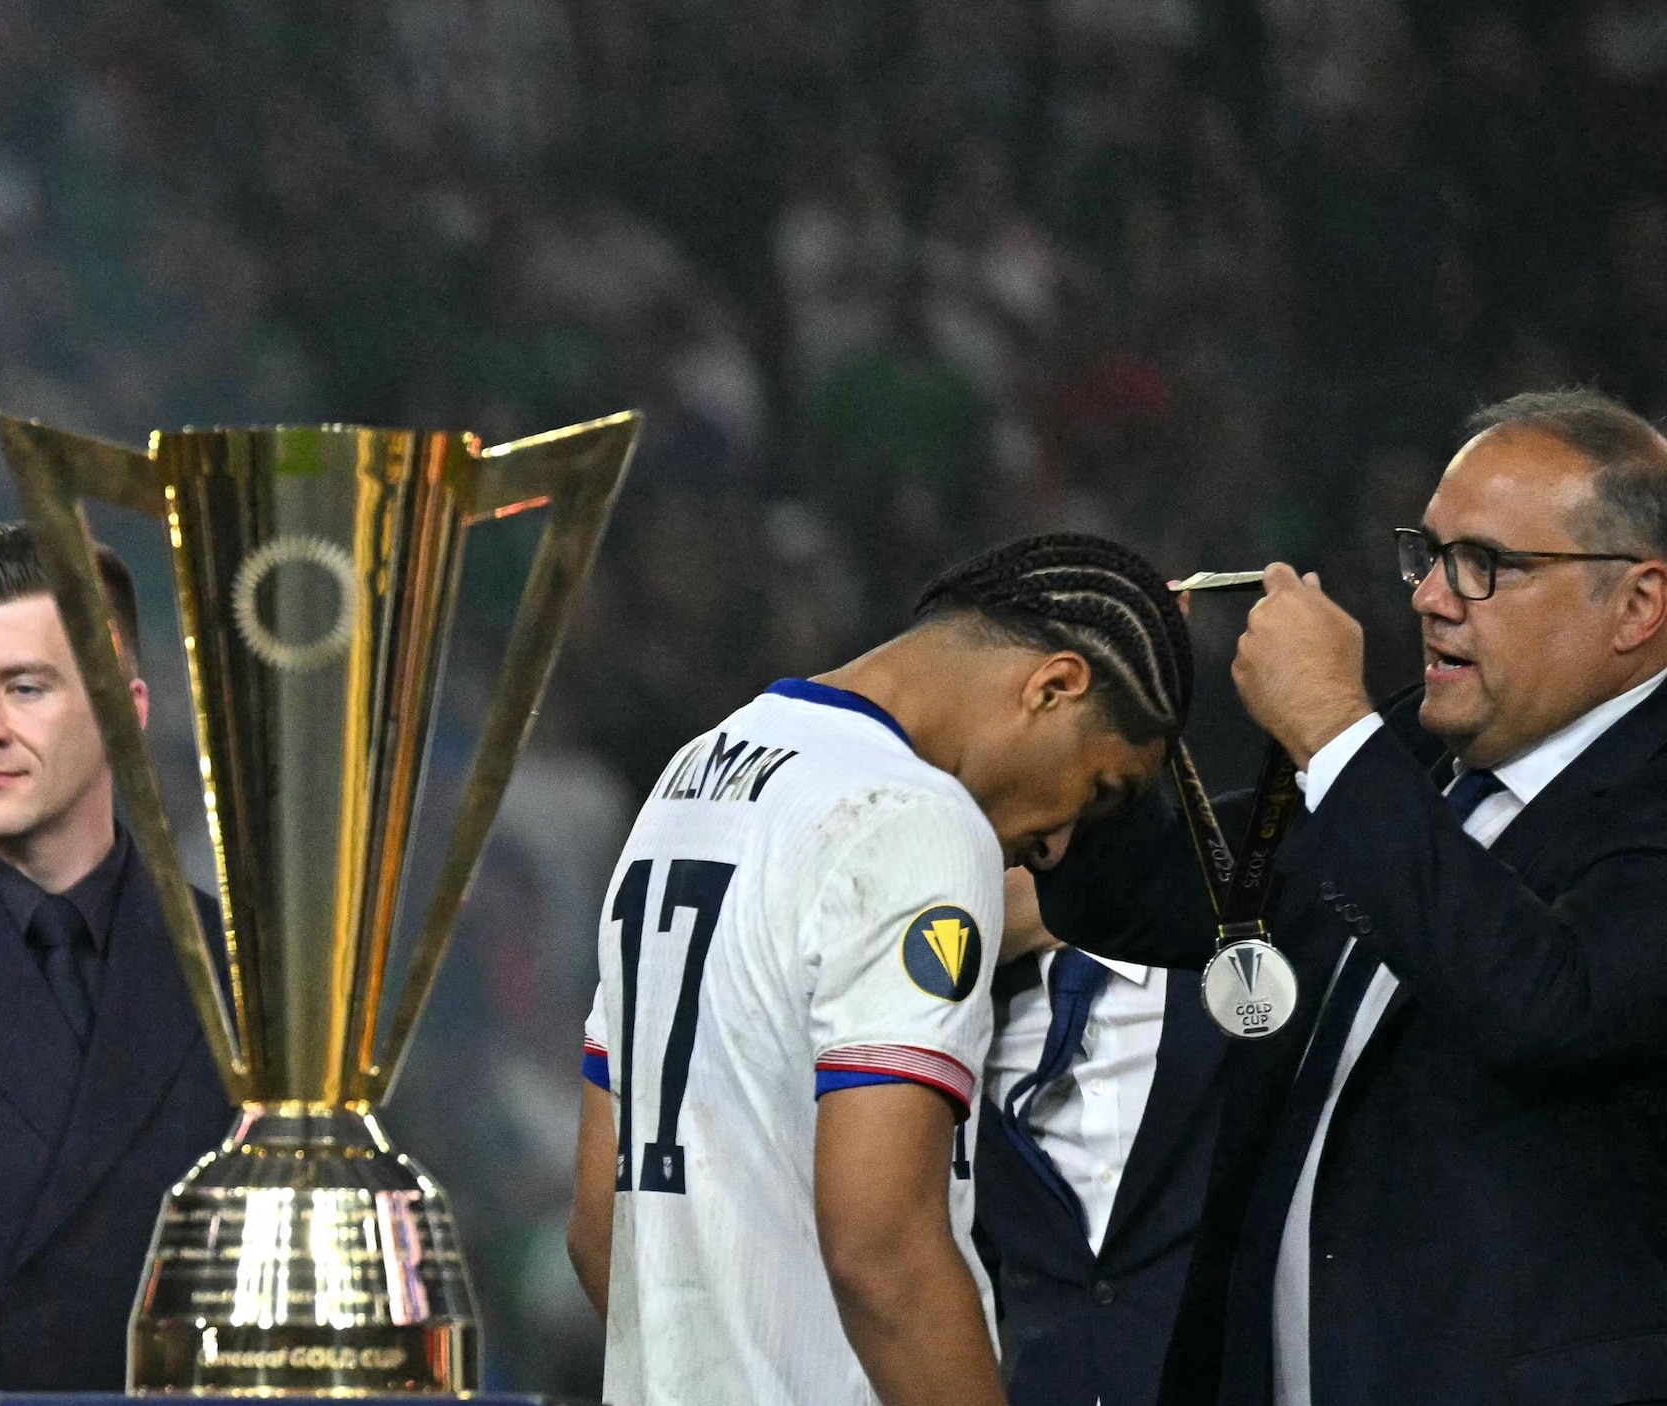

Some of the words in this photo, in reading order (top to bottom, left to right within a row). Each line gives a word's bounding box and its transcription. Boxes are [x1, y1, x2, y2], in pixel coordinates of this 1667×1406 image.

[1236, 1003, 1272, 1016] GOLD
[611, 859, 737, 1194] 17
[1242, 1014, 1269, 1026] CUP
[288, 1347, 358, 1369] GOLD
